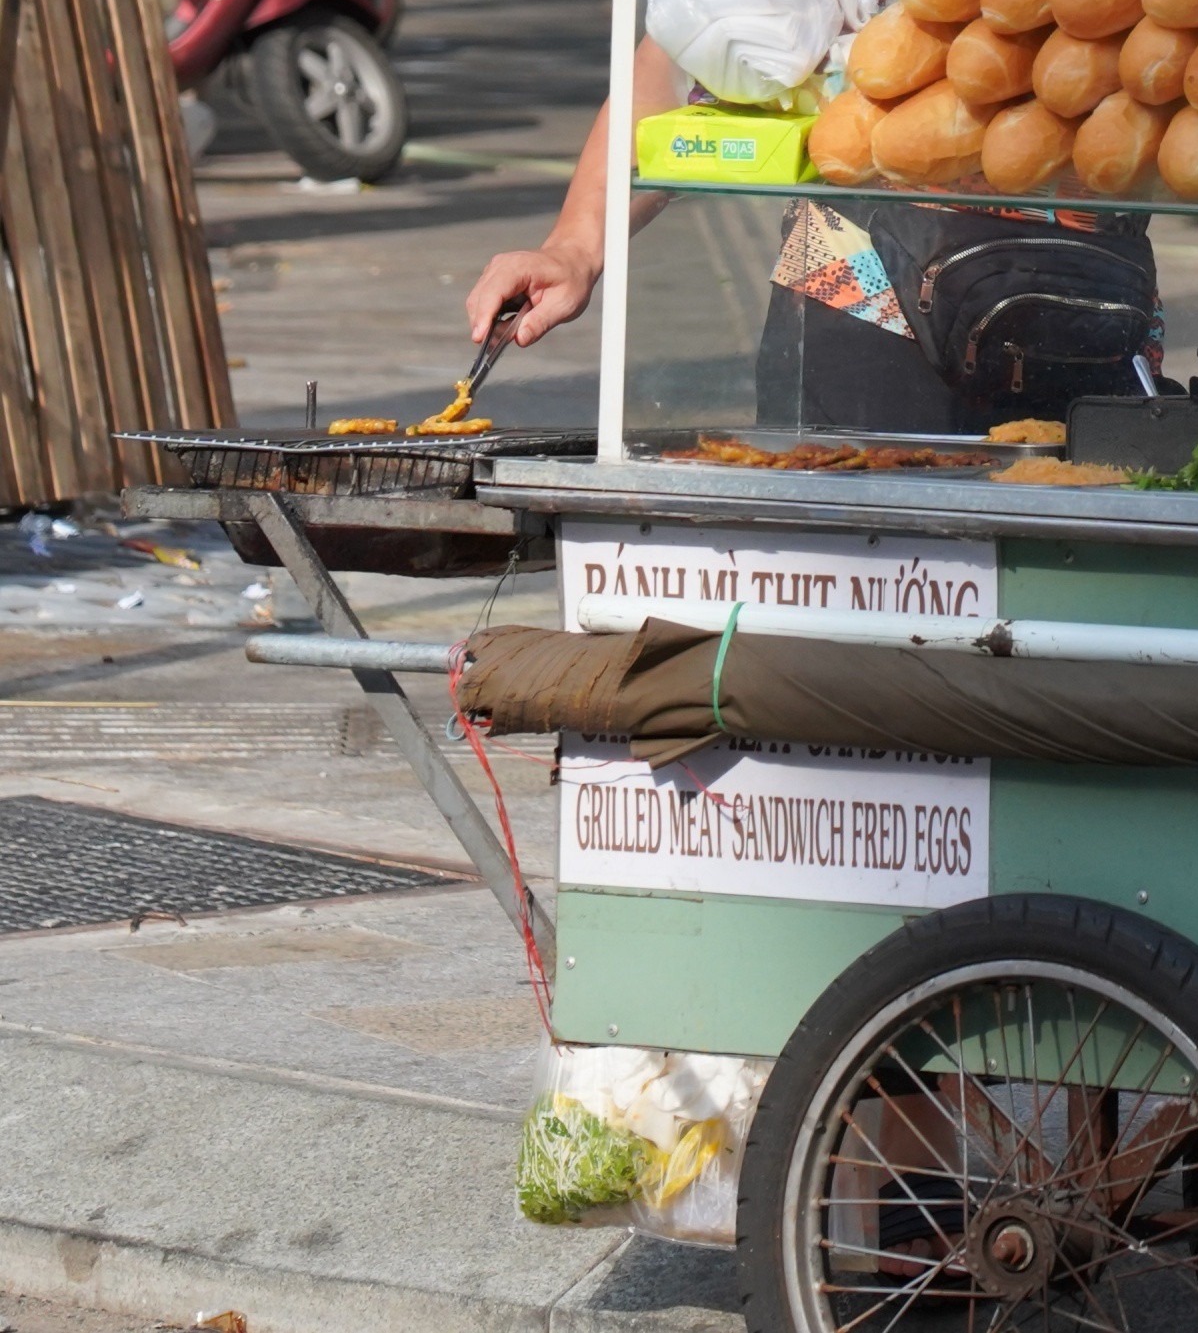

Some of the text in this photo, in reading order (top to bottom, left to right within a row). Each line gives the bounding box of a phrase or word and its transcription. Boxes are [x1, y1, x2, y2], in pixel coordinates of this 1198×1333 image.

[576, 783, 972, 876] GRILLED MEAT SANDWICH FRED EGGS
